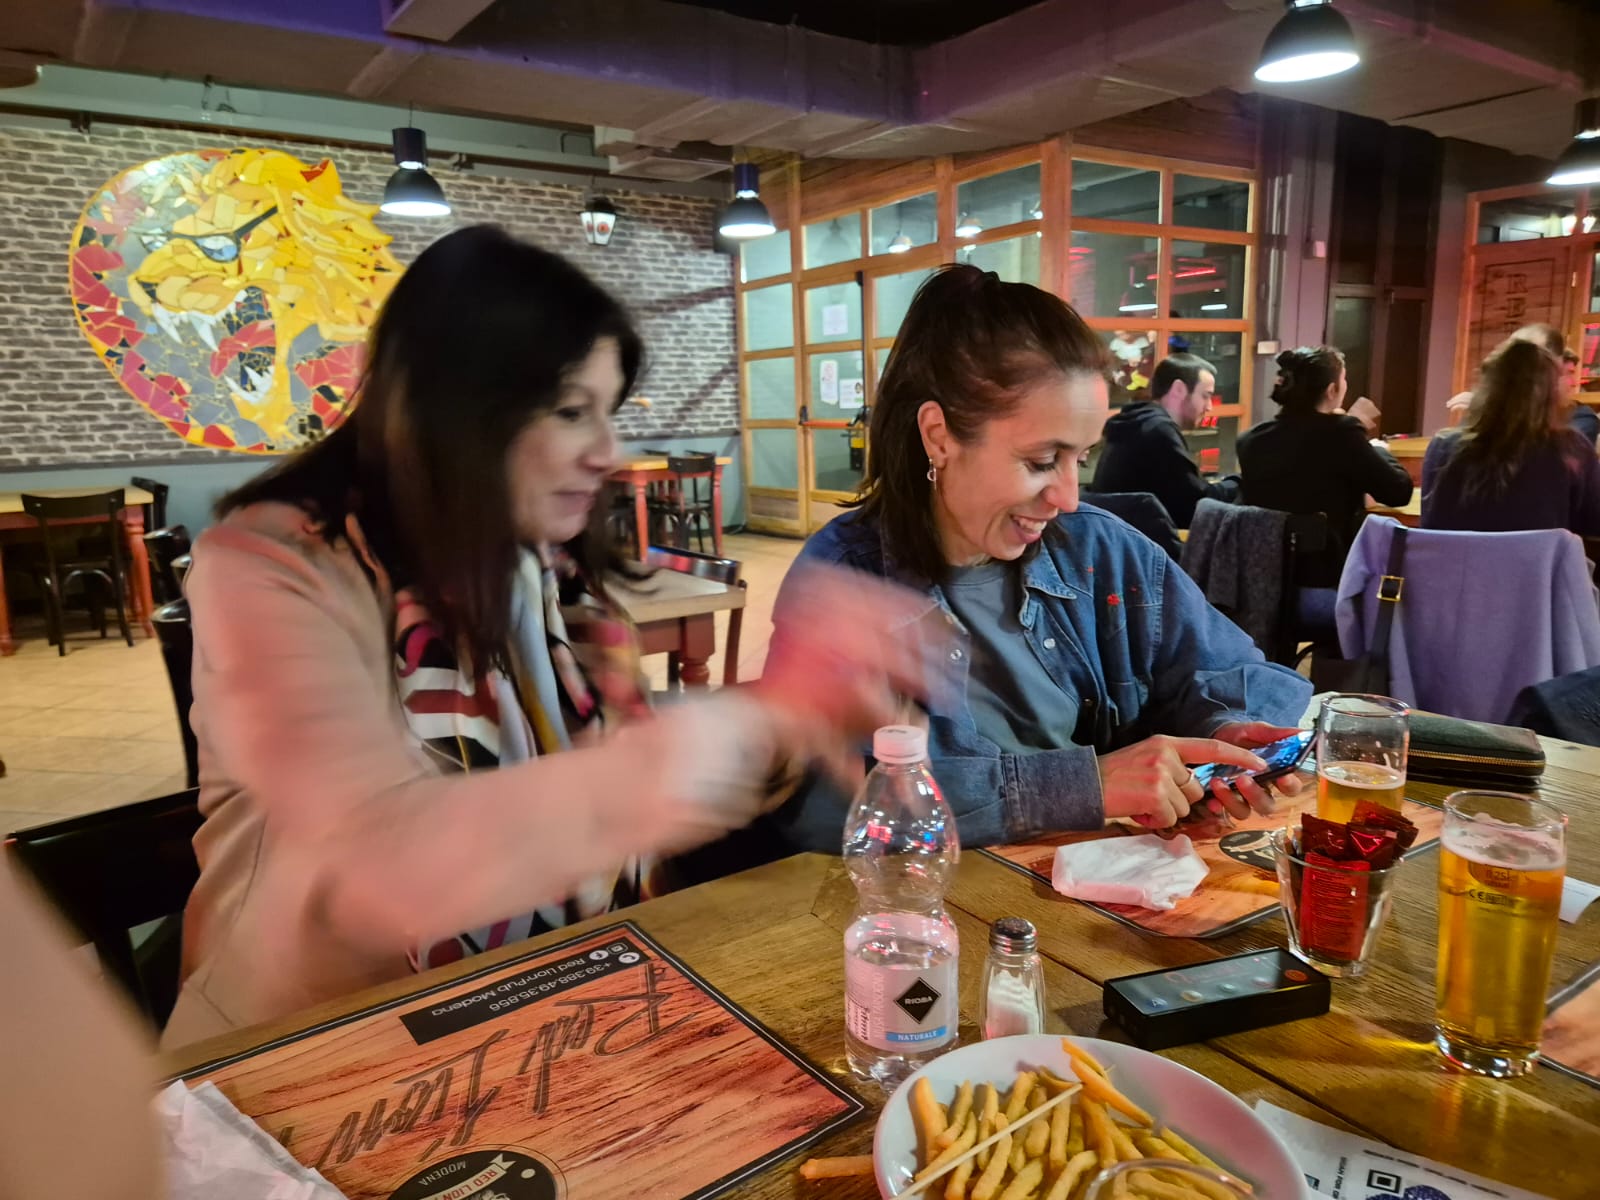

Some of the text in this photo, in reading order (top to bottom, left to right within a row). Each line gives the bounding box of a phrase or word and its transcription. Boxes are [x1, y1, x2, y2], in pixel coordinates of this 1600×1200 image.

[558, 957, 586, 972] Red
[431, 988, 498, 1017] Modena
[518, 962, 701, 1119] Red
[897, 1030, 938, 1042] NATURALE
[418, 1159, 467, 1186] MODENA
[475, 1168, 498, 1188] RED
